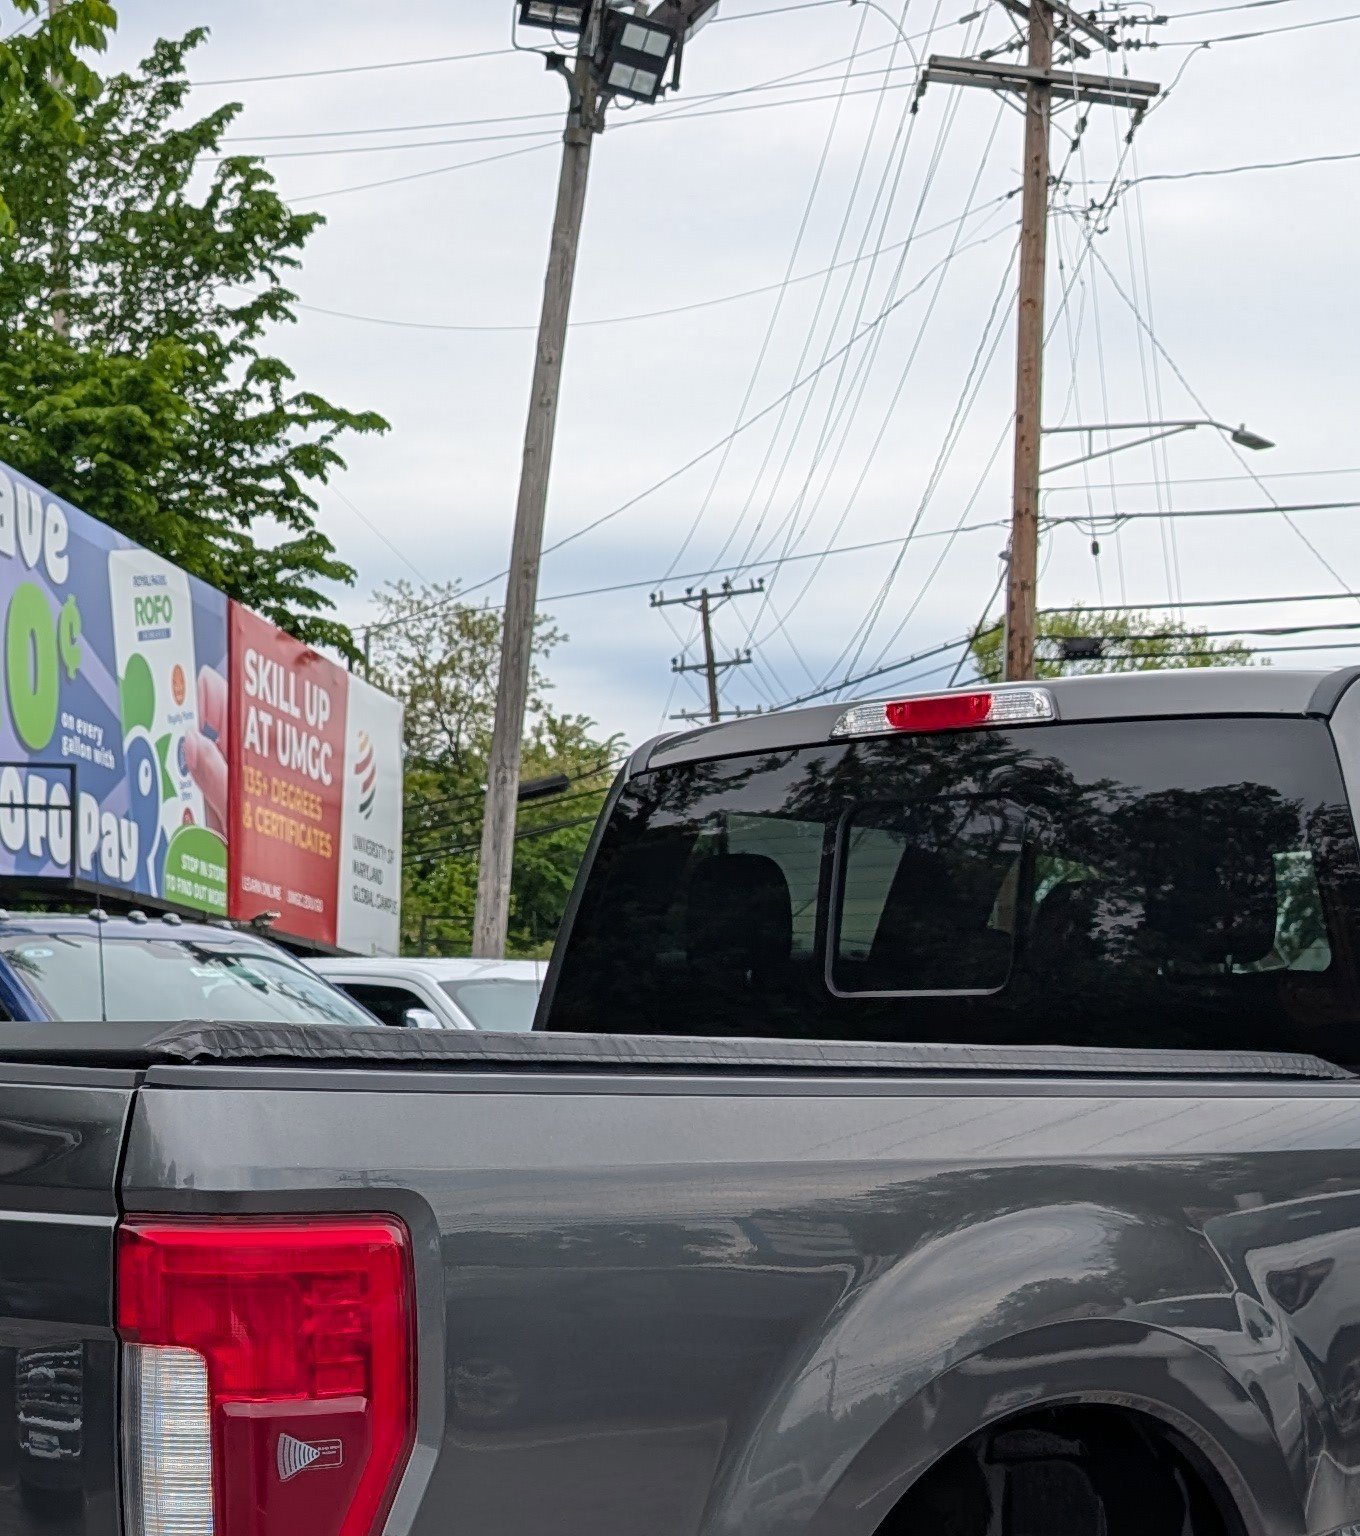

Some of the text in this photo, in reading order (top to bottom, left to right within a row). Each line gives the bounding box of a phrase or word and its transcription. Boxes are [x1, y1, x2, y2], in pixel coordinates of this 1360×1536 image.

[134, 595, 173, 627] ROFO
[244, 648, 301, 720] SKILL
[304, 680, 331, 731] UP
[60, 711, 104, 748] on every
[61, 735, 115, 771] gallon with
[243, 705, 333, 786] AT UMGC
[271, 776, 324, 822] DEGREES
[78, 791, 139, 884] Pay
[242, 800, 333, 859] & CERTIFICATES
